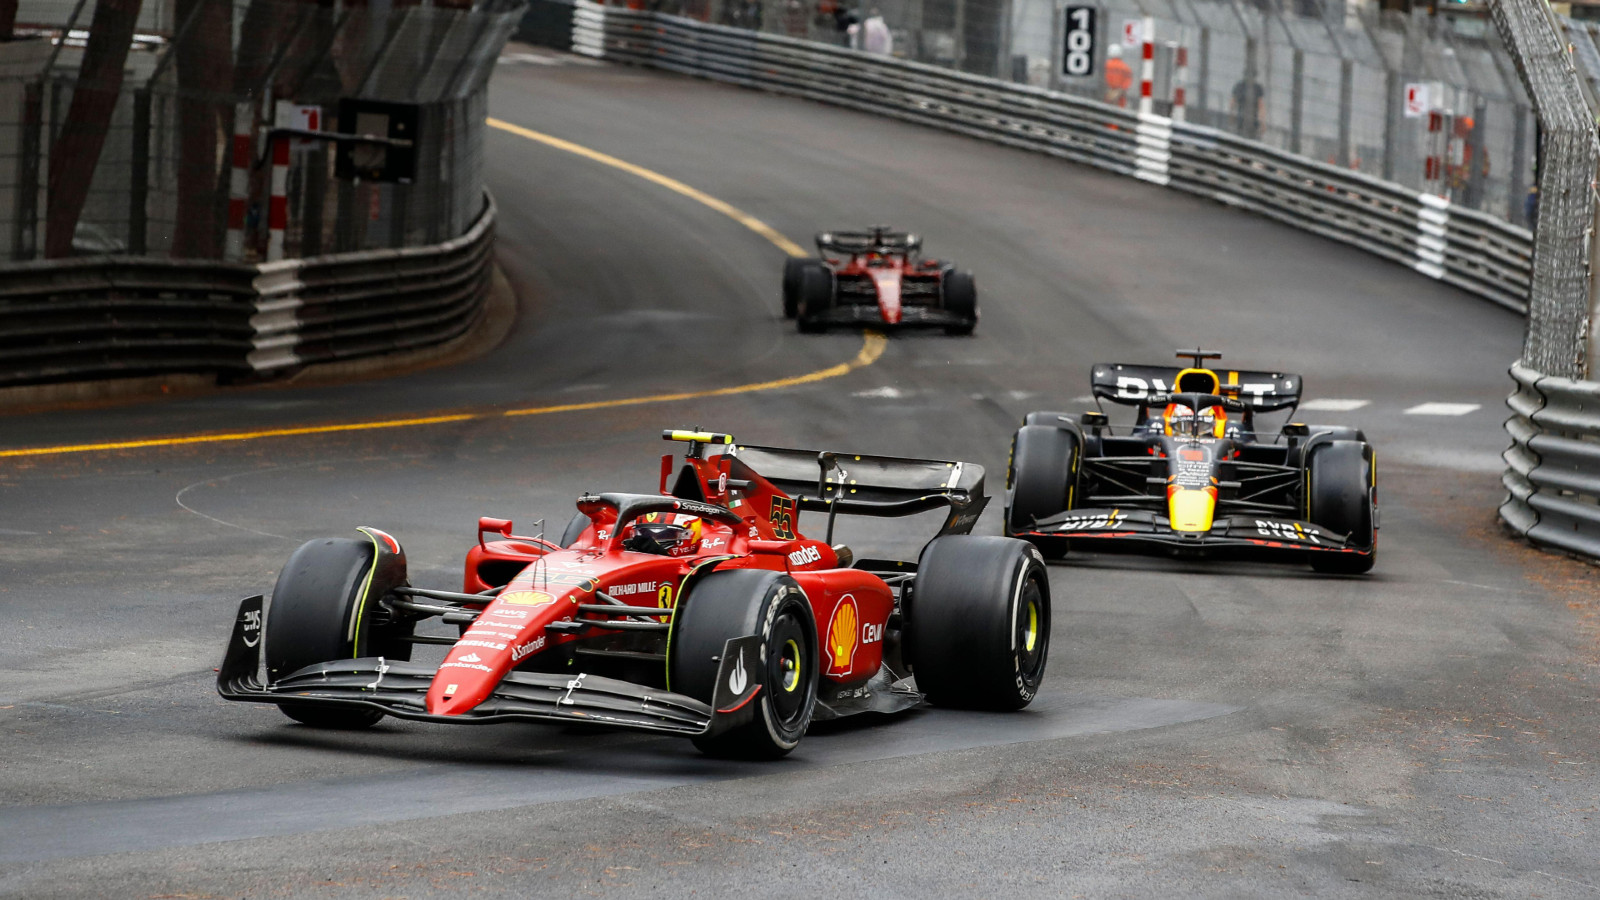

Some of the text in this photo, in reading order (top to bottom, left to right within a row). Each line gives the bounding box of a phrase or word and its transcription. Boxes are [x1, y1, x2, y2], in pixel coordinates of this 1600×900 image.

[1066, 8, 1092, 75] 100
[681, 502, 721, 516] Snapdragon
[769, 494, 797, 541] 55
[608, 581, 657, 596] RICHARD MILLE
[517, 636, 546, 659] Santander
